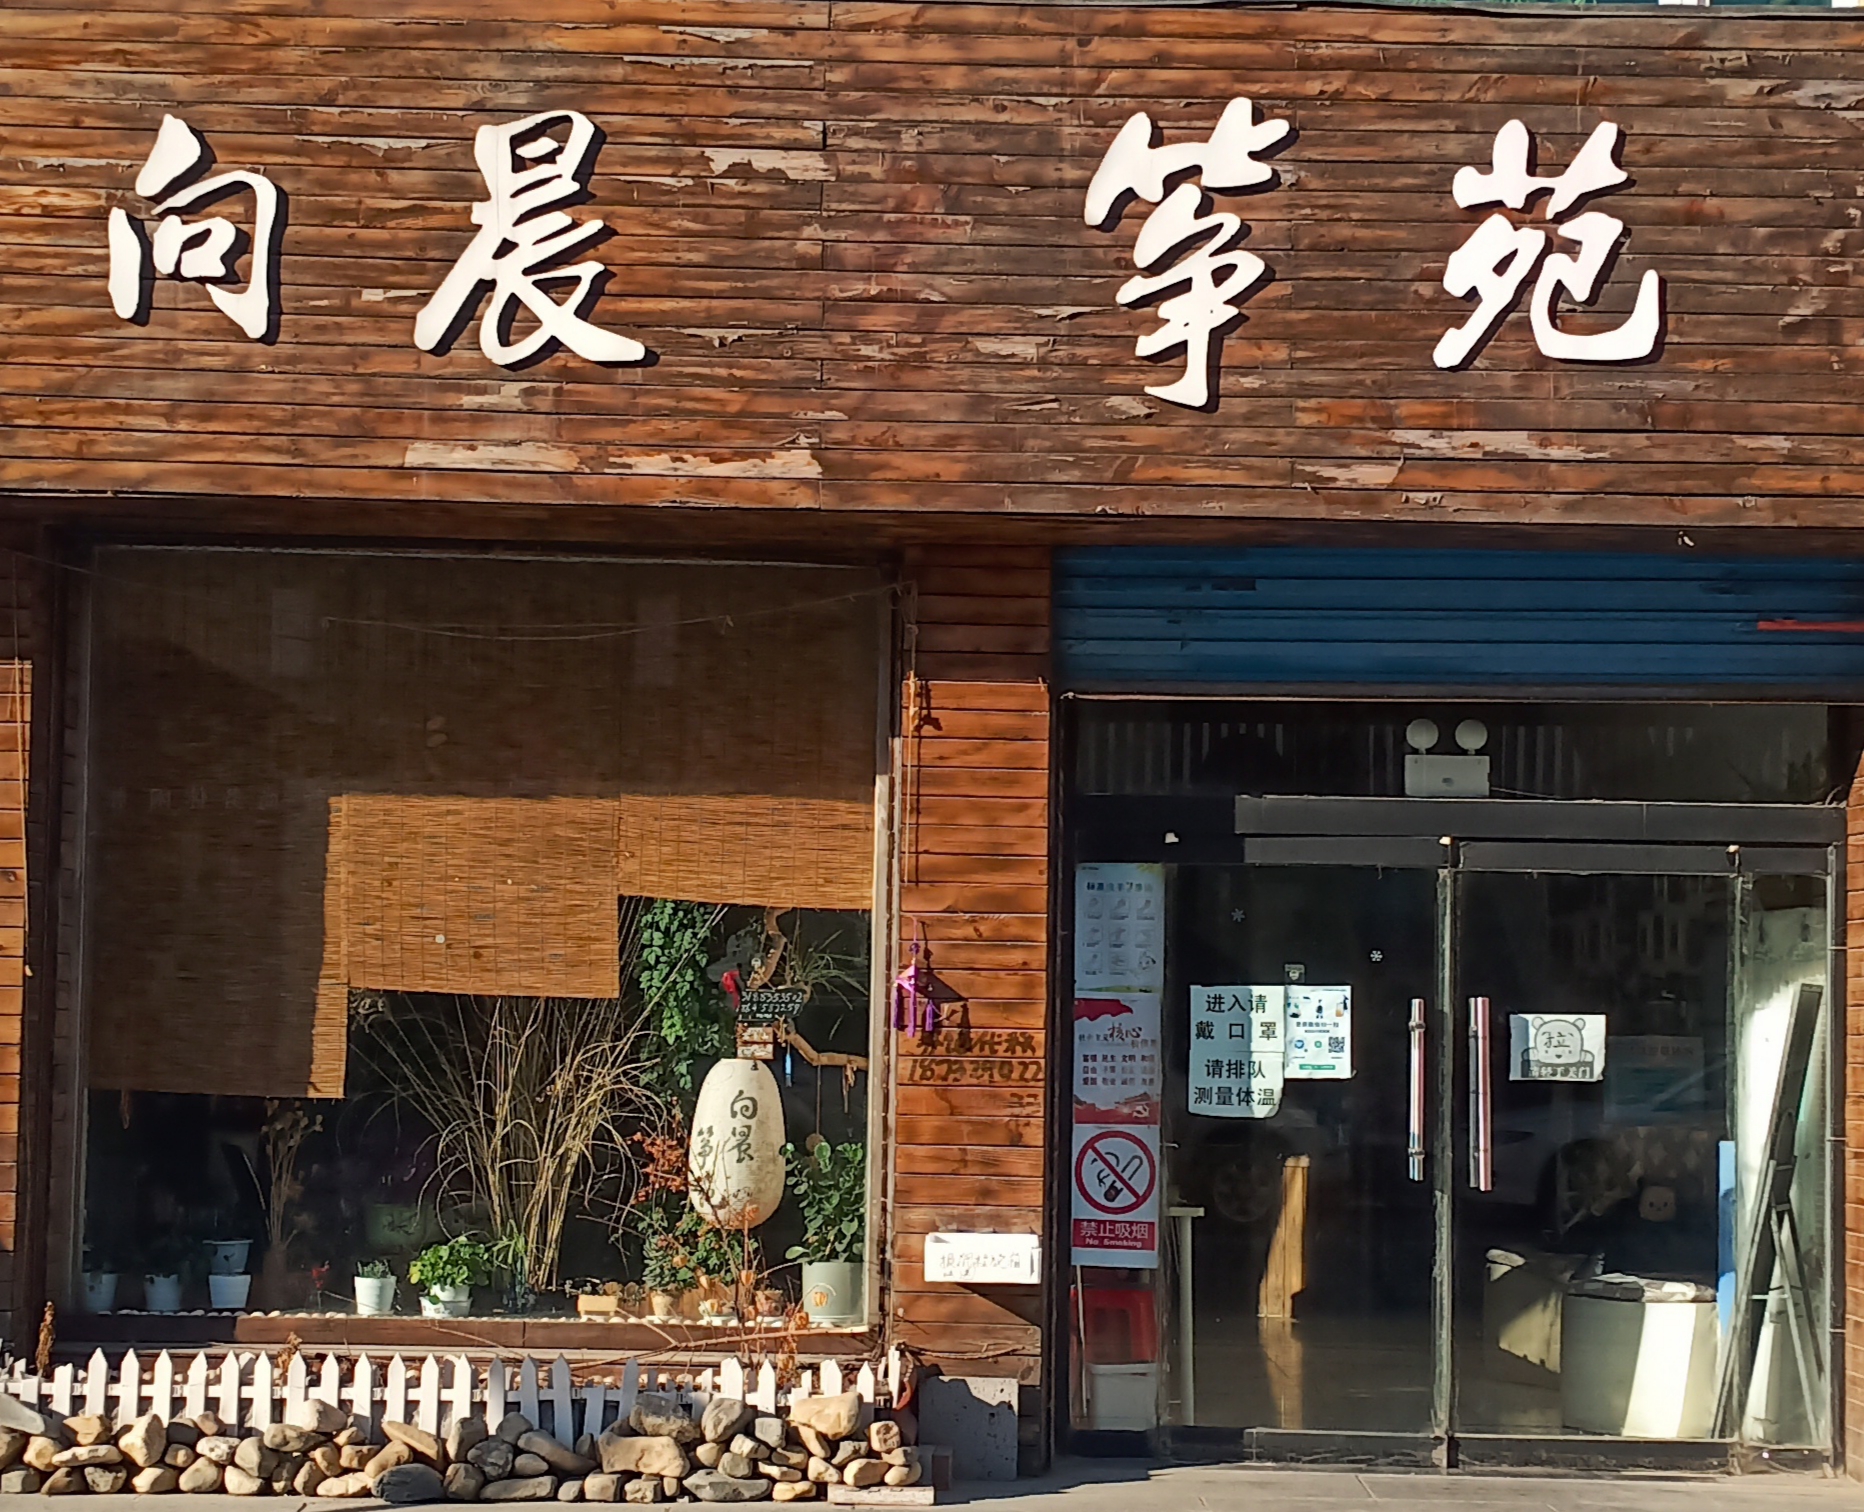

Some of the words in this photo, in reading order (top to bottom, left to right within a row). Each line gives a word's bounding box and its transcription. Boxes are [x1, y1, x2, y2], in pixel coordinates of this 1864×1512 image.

[1205, 993, 1267, 1013] 进入请
[1107, 1022, 1143, 1042] 核心
[1195, 1021, 1277, 1041] 戴口罩
[1543, 1031, 1571, 1048] 拉
[1204, 1059, 1266, 1080] 请排队
[1193, 1086, 1276, 1107] 测量体温
[1080, 1221, 1149, 1239] 禁止吸烟
[1103, 1238, 1142, 1248] Smoking
